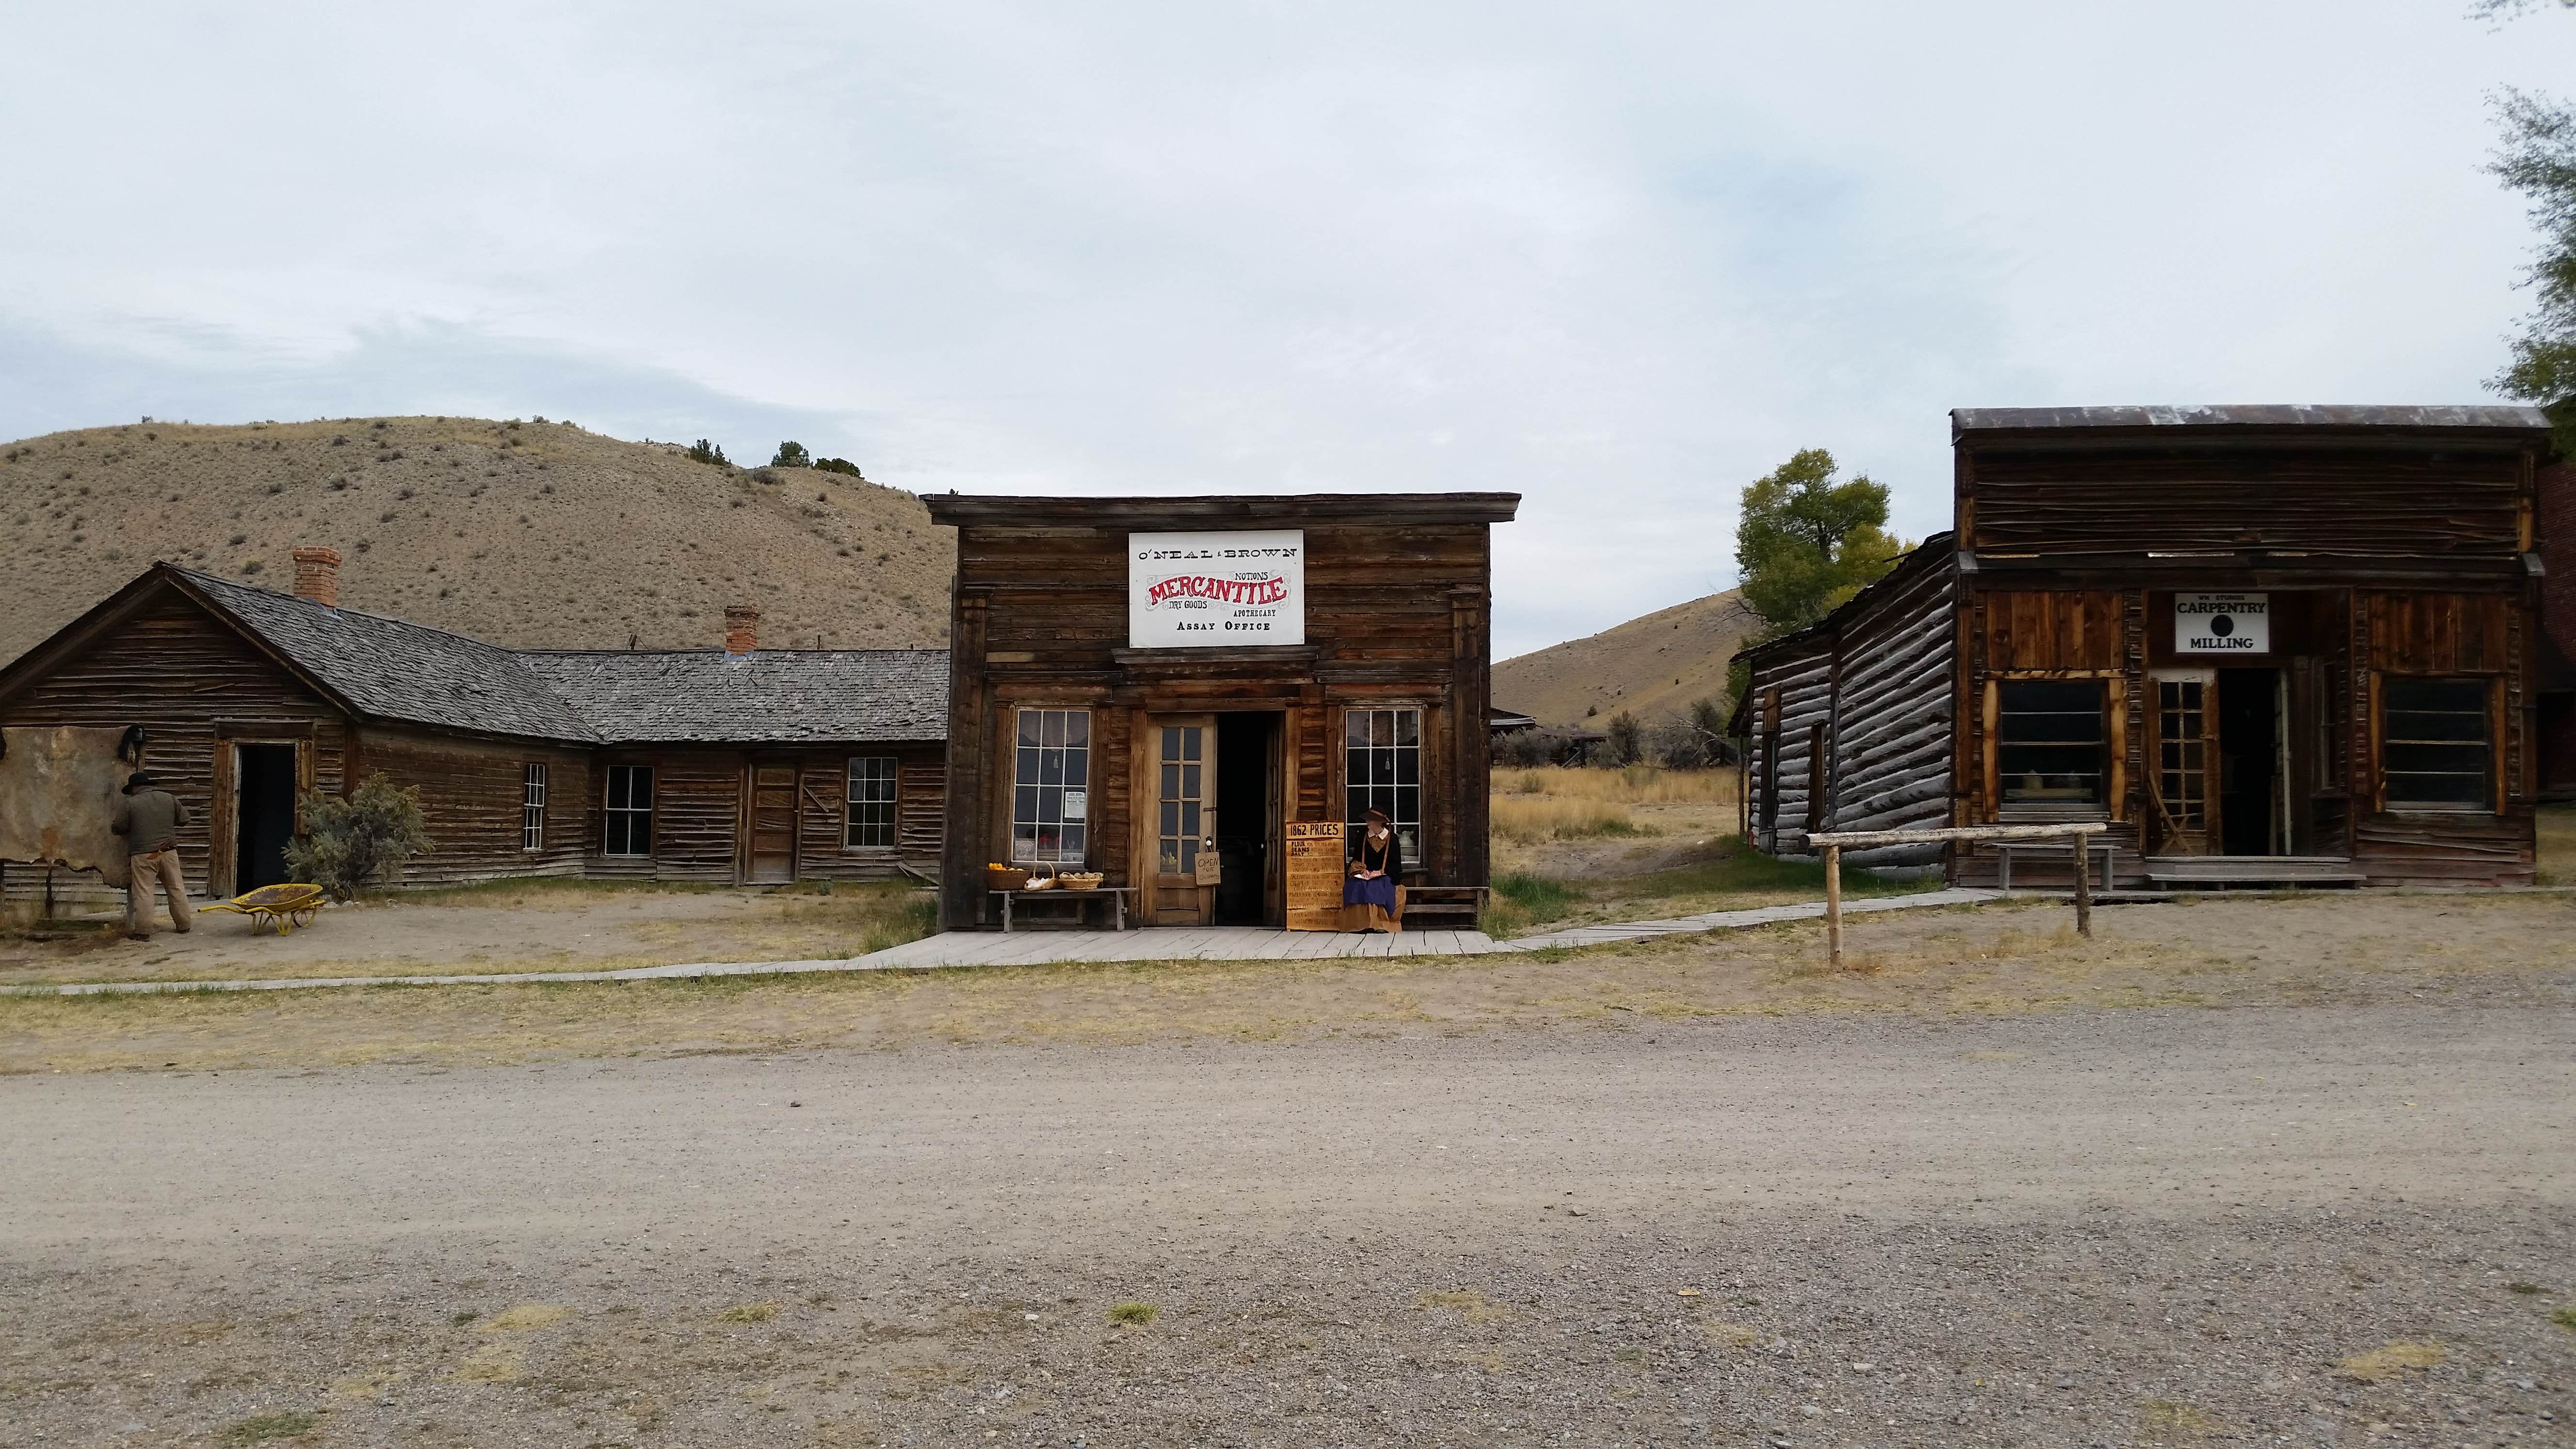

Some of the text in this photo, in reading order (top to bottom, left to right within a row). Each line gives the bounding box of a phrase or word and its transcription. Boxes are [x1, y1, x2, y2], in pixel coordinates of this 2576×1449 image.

[1139, 548, 1213, 560] O'NEAL
[1224, 548, 1297, 558] BROWN
[1235, 572, 1268, 580] NOTIONS
[1148, 576, 1287, 606] MERCANTILE
[1169, 600, 1208, 610] DRY GOODS
[2177, 602, 2266, 613] CARPENTRY
[1233, 609, 1276, 617] APOTHECARY
[2190, 638, 2254, 649] MILLING
[1290, 824, 1339, 836] 1862 PRICES
[1198, 857, 1219, 867] OPEN
